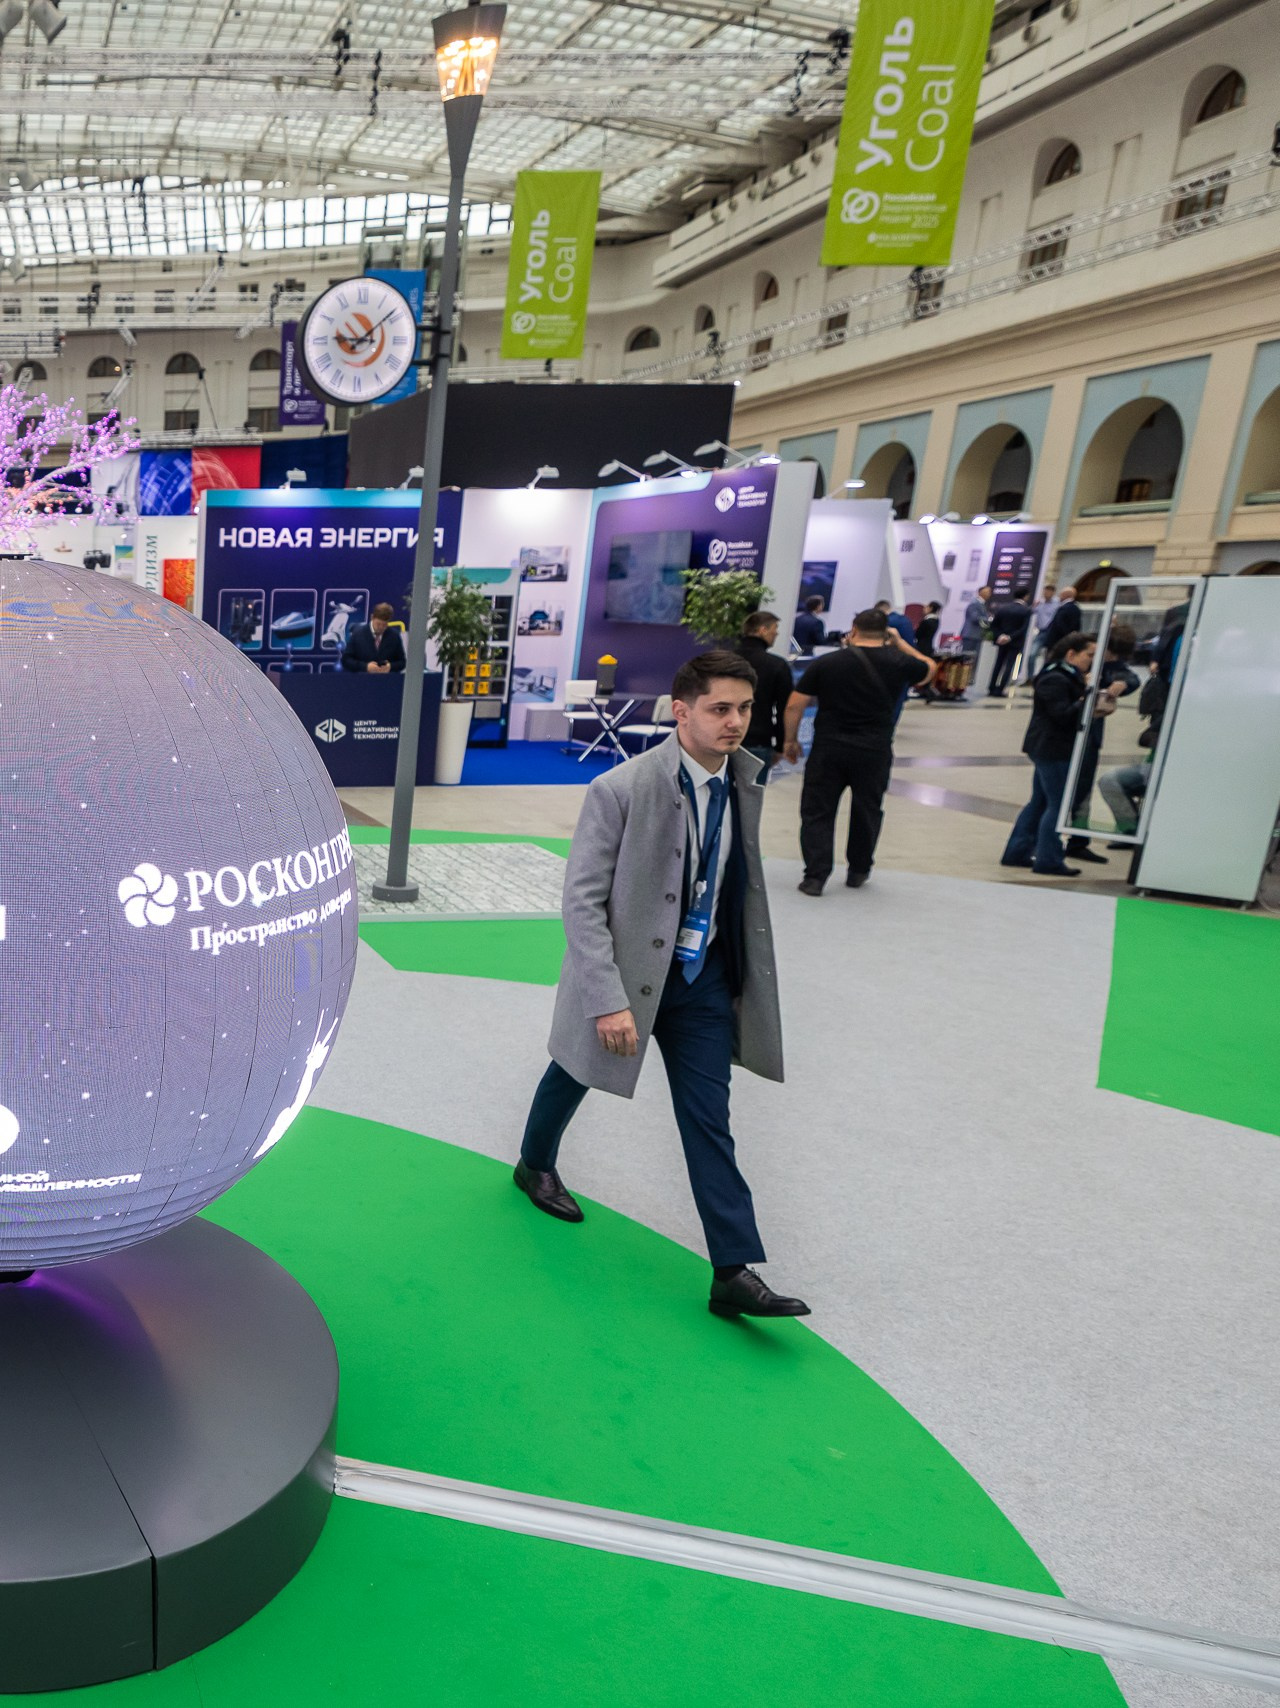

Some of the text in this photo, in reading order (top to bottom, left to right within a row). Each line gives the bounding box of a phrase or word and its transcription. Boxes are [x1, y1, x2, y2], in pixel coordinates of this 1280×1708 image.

[855, 16, 915, 175] Уголь
[905, 65, 956, 172] Coal
[519, 209, 551, 304] Уголь
[548, 237, 577, 303] Coal
[219, 527, 313, 548] НОВАЯ
[190, 908, 318, 955] Пространство
